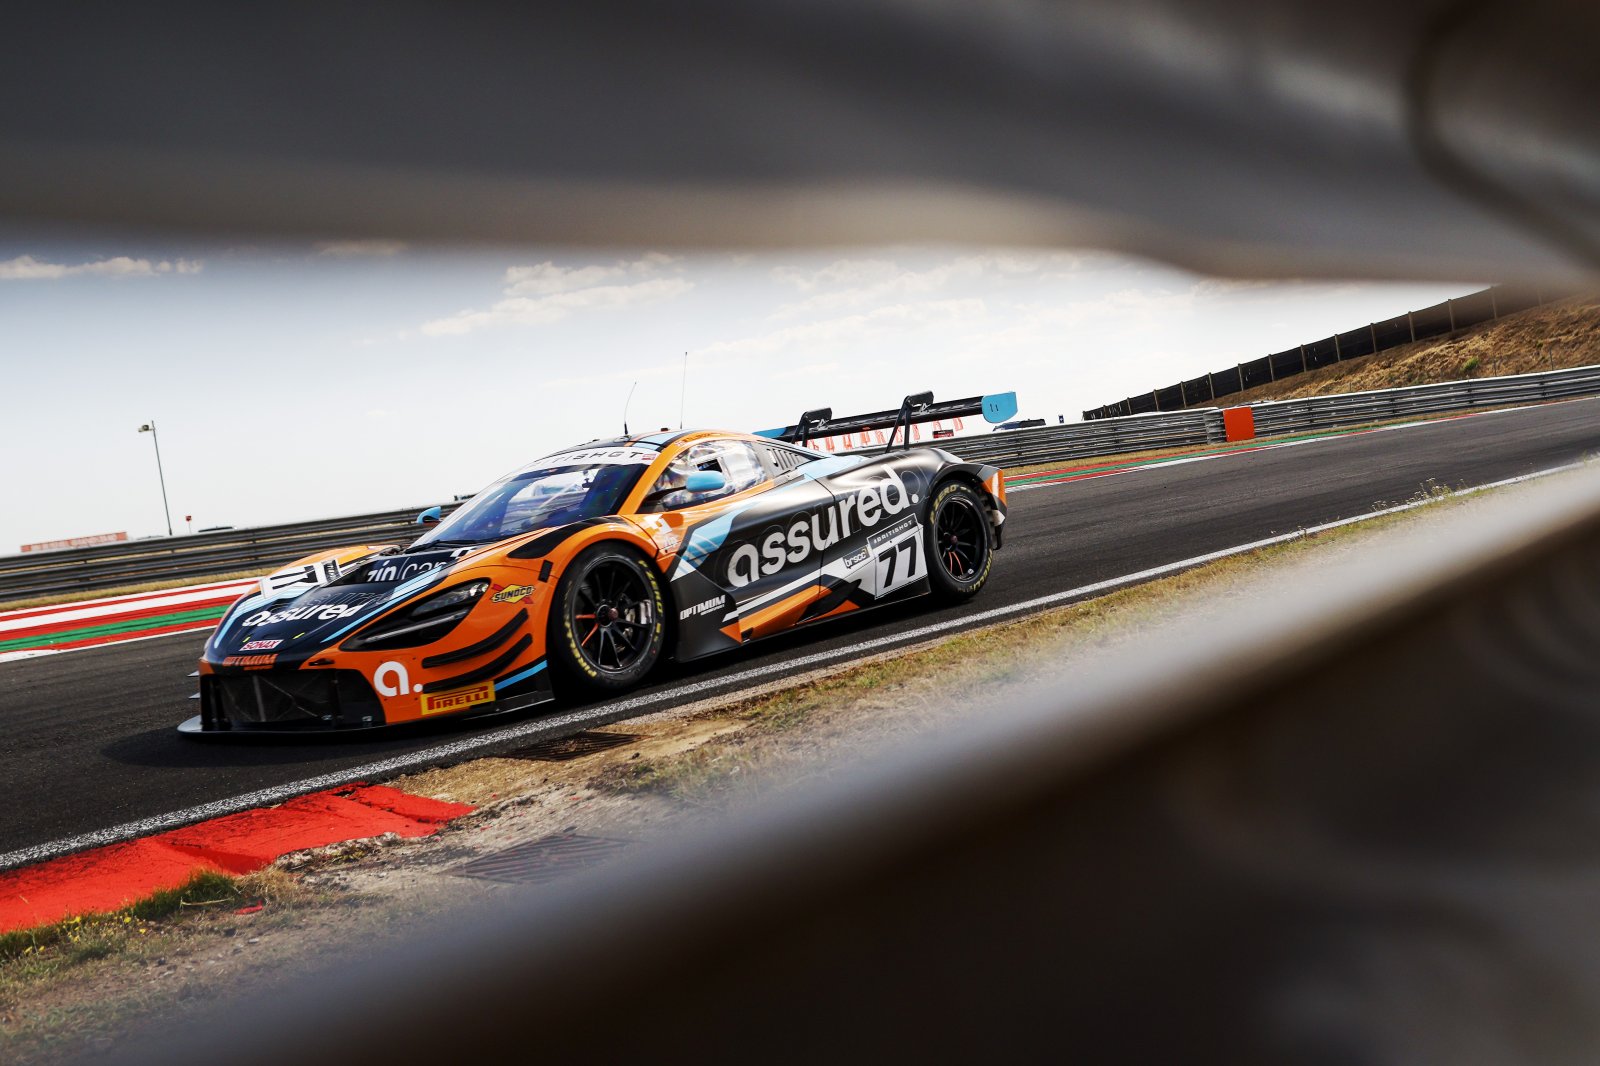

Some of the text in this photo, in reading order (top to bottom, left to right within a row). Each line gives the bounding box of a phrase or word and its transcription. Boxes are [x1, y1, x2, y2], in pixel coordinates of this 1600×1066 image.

[727, 463, 920, 588] assured.
[878, 535, 917, 589] 77
[491, 585, 534, 603] SUNOCO
[679, 594, 726, 620] OPTIMUM
[242, 640, 282, 650] SONAX
[373, 660, 424, 698] a.
[427, 685, 489, 711] PIRELLI
